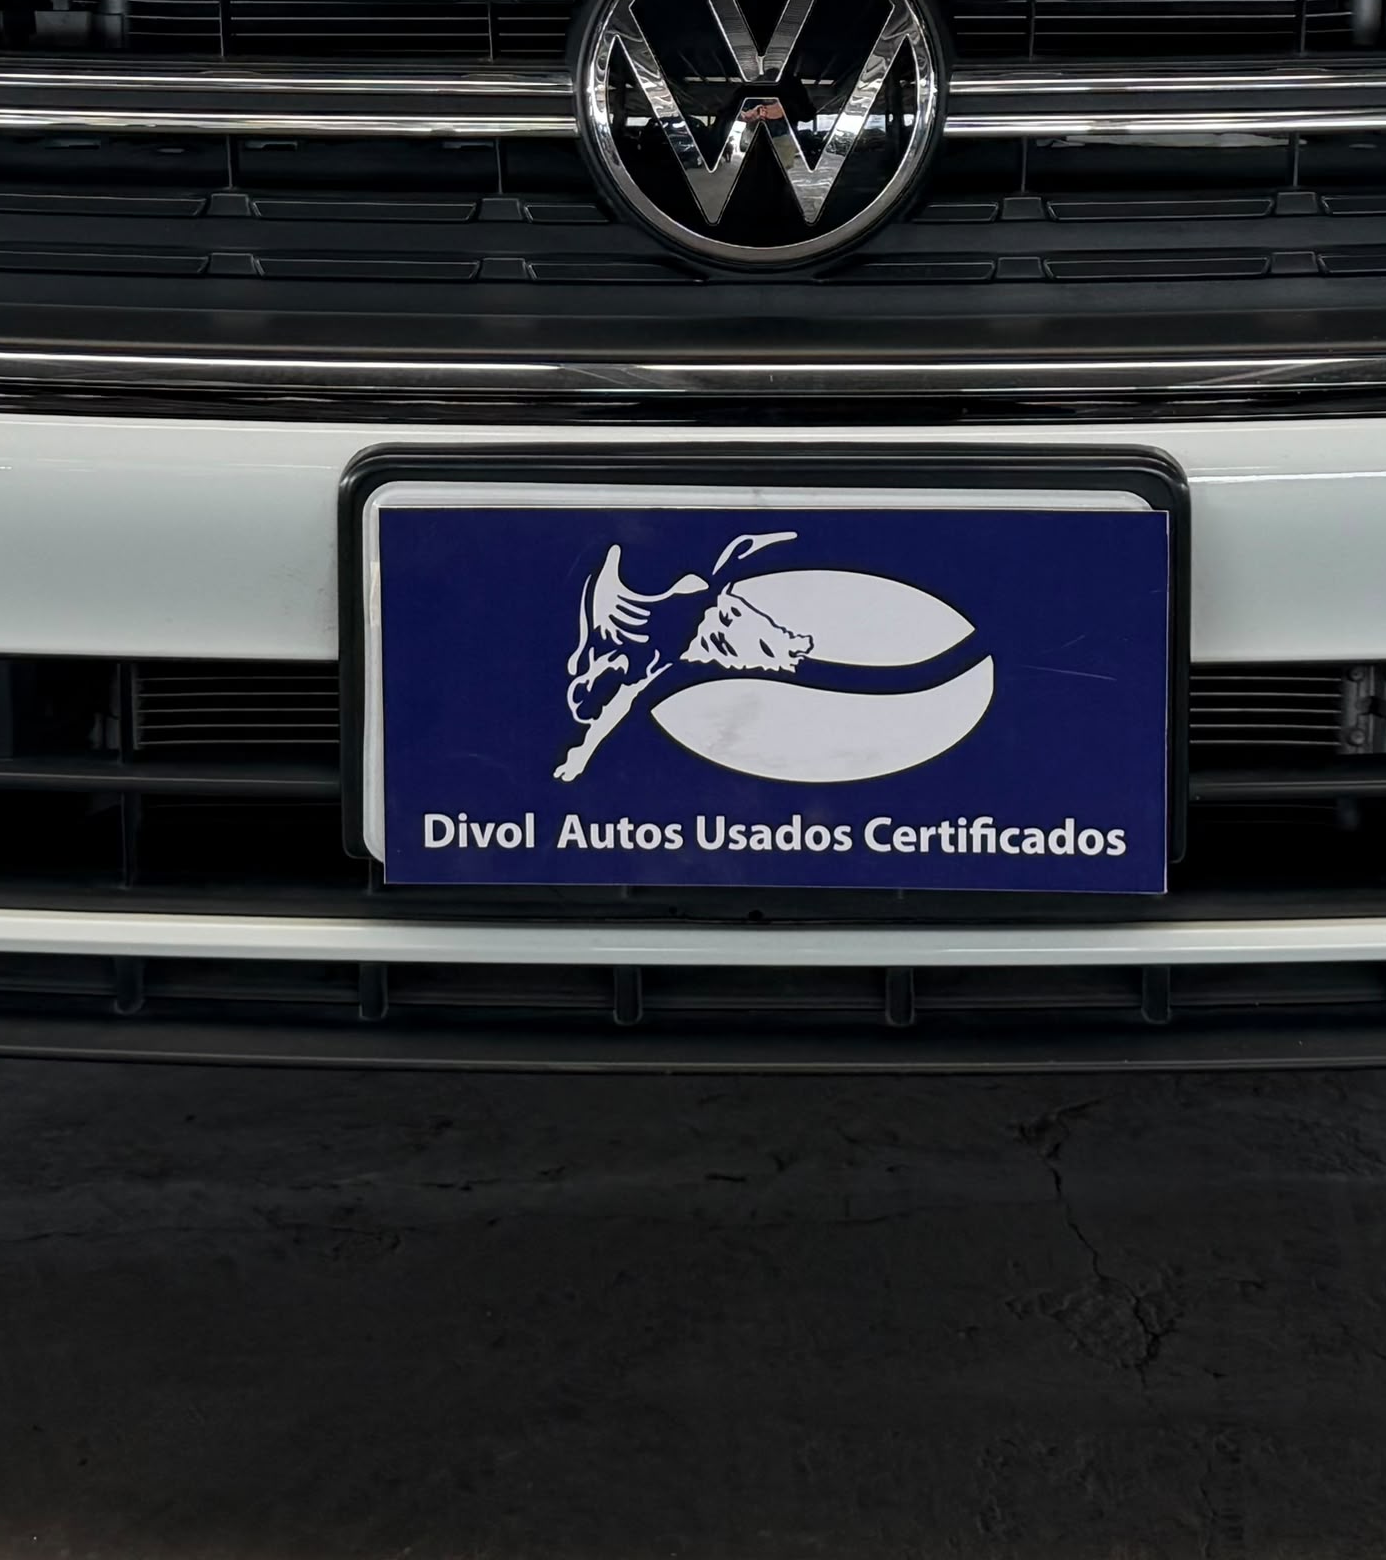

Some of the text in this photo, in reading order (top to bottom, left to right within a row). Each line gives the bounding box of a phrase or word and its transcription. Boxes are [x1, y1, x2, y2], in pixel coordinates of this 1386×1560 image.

[423, 811, 1127, 857] Divol Autos Usados Certificados
